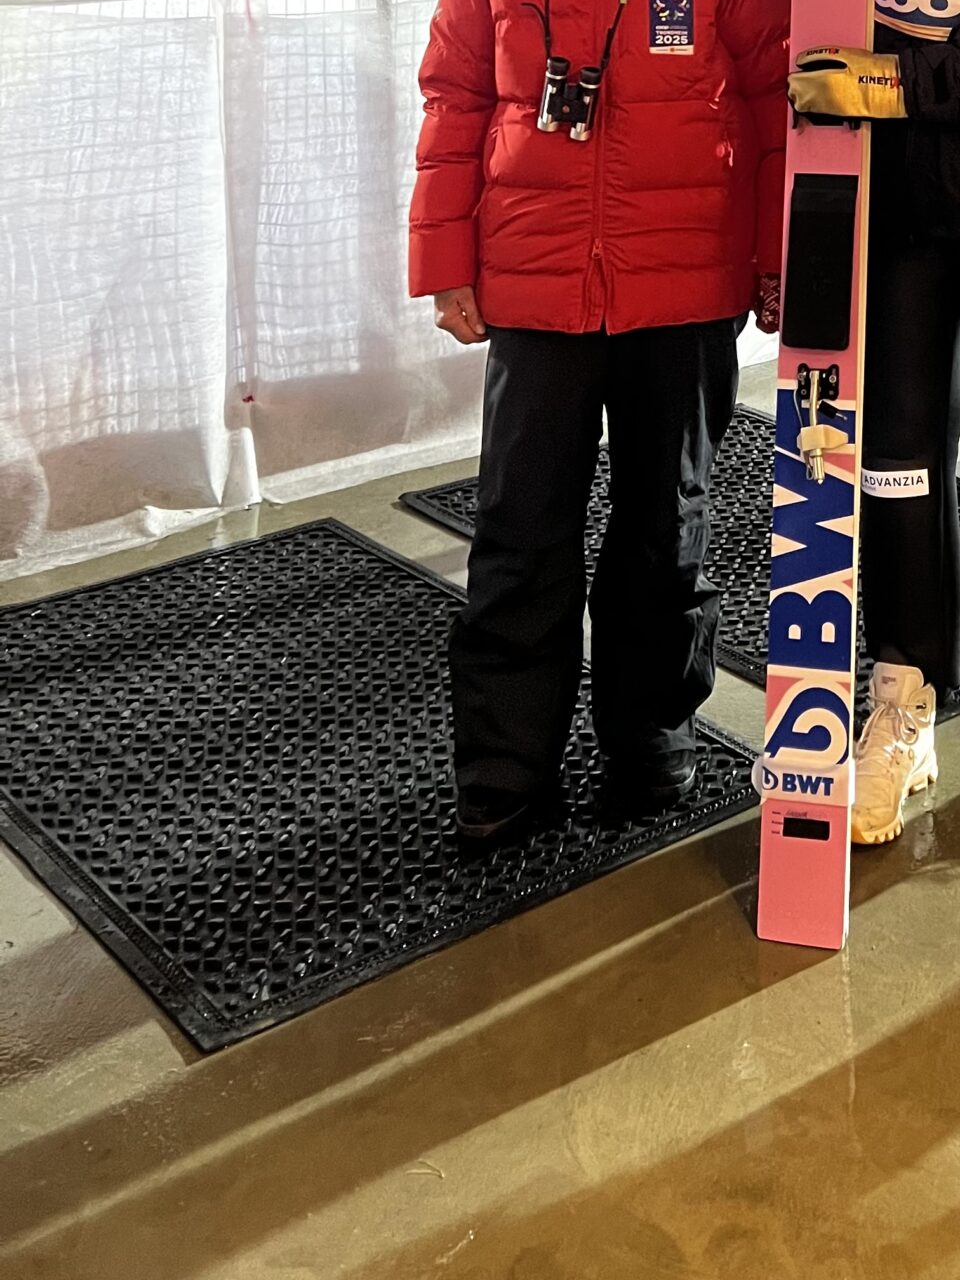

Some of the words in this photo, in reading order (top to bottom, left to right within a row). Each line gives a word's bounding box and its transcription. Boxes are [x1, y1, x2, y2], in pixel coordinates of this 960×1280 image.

[655, 35, 688, 45] 2025
[864, 475, 924, 487] ADVANZIA
[768, 388, 856, 672] BWT
[782, 773, 834, 796] BWT
